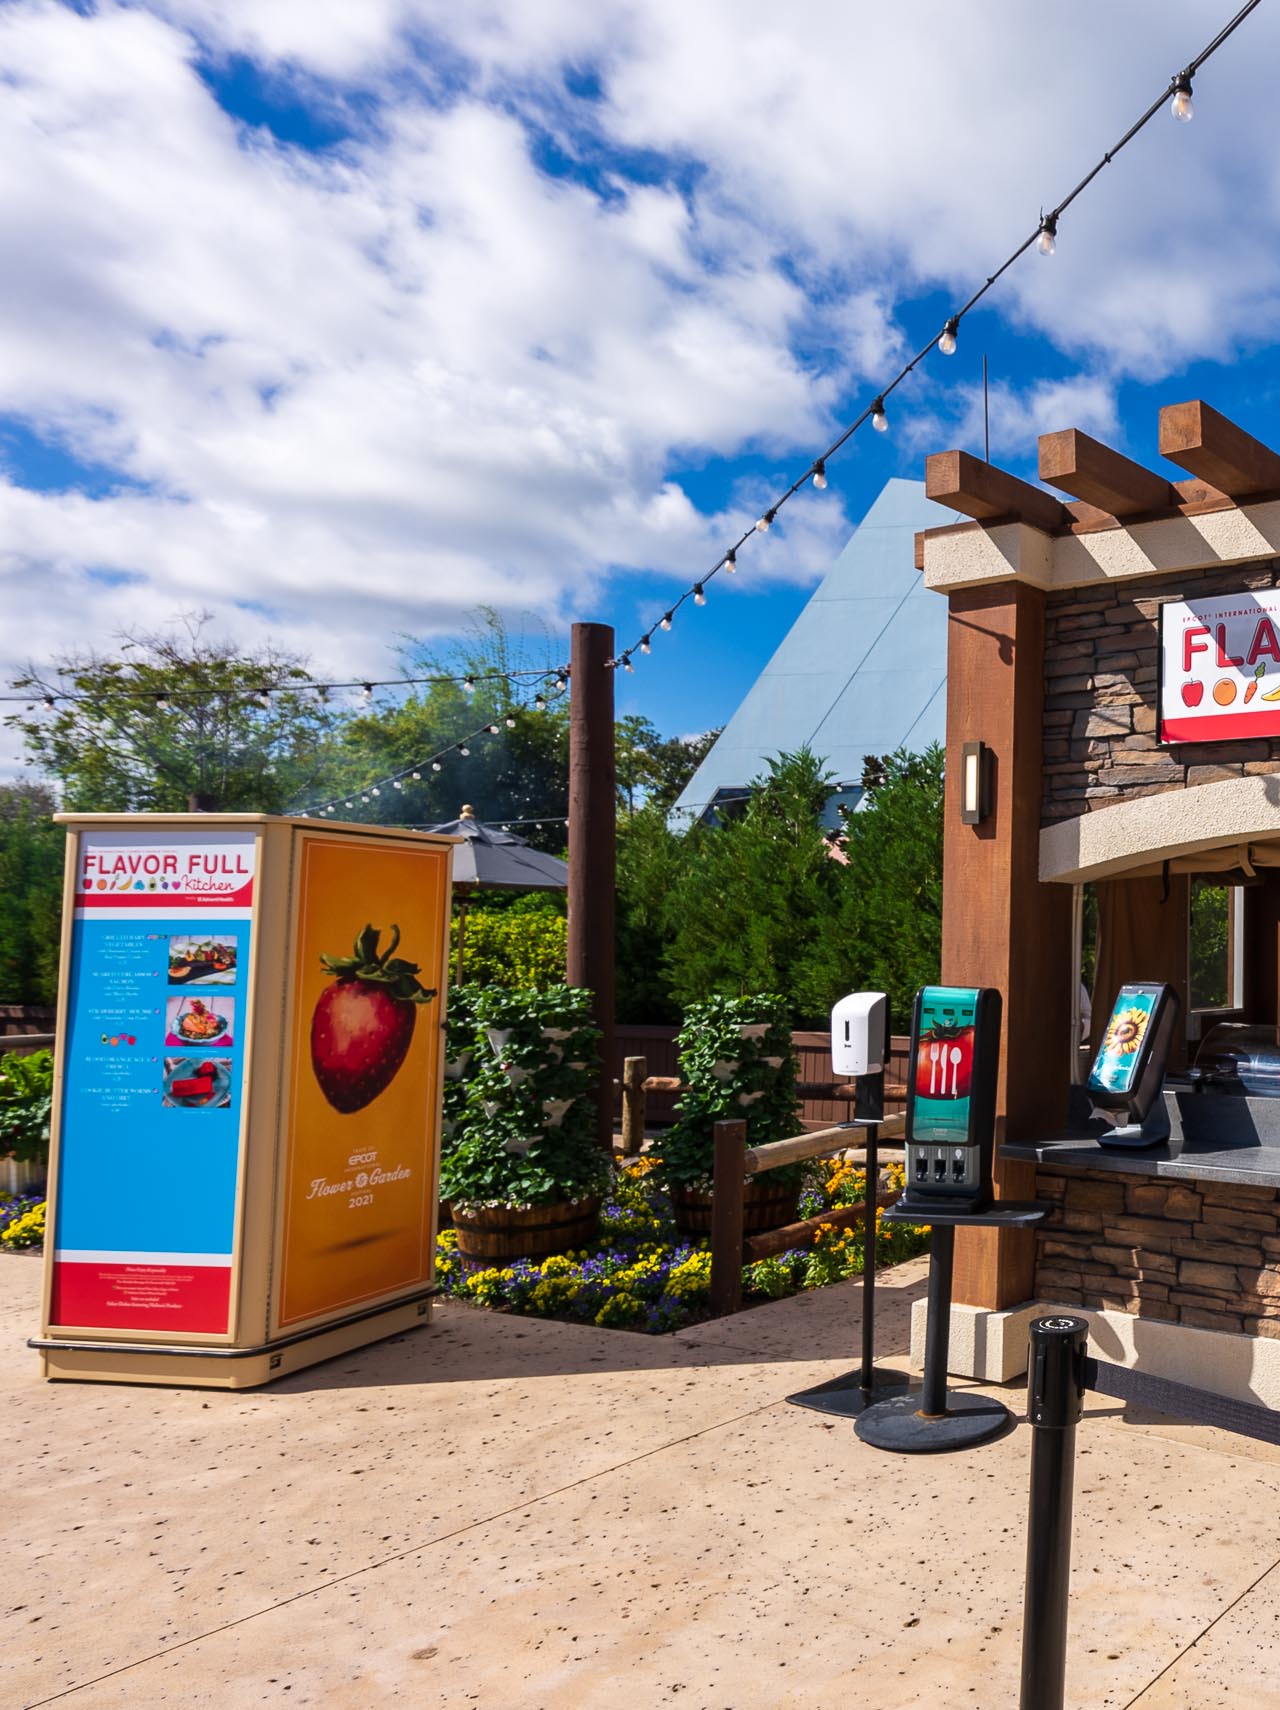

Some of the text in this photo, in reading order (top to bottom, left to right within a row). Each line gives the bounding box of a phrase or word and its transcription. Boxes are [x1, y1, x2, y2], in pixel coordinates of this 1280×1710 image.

[1215, 606, 1278, 619] INTERNATIONAL
[83, 854, 249, 874] FLAVOR FULL
[181, 874, 235, 891] Kitchen
[306, 1177, 353, 1200] Flower
[369, 1163, 412, 1185] Garden
[348, 1194, 374, 1208] 2021
